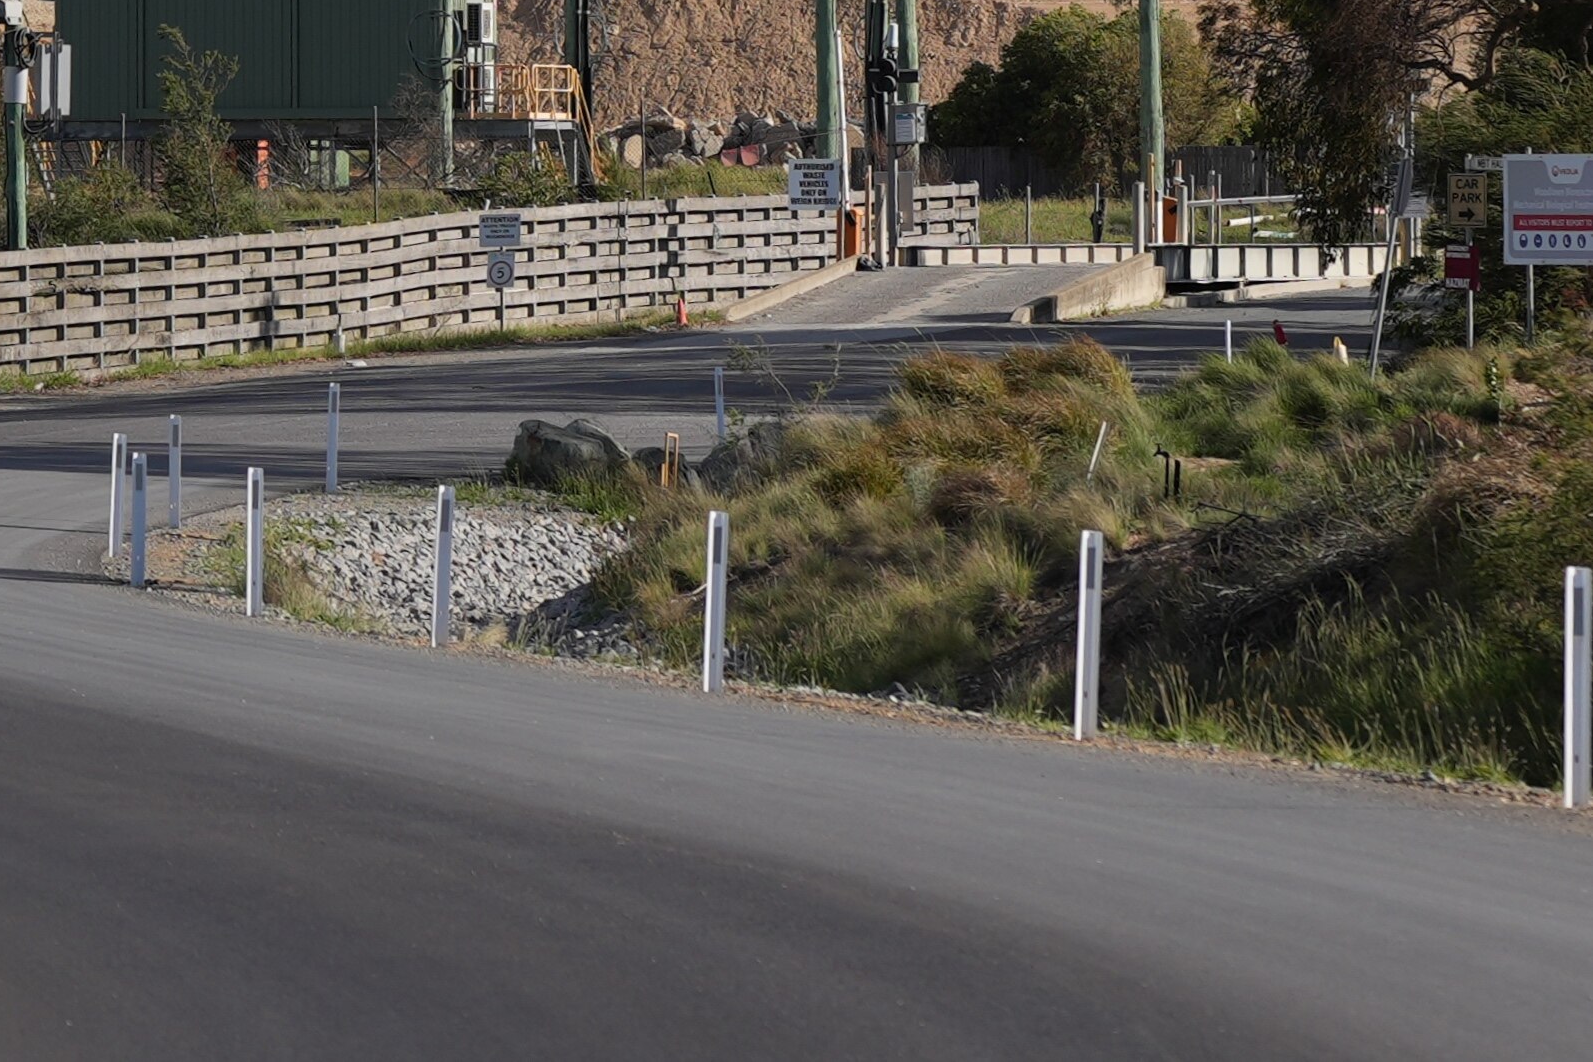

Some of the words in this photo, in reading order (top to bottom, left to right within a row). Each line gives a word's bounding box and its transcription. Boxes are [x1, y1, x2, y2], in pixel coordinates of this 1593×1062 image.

[1456, 178, 1479, 189] CAR
[1452, 192, 1482, 203] PARK
[496, 267, 505, 279] 5
